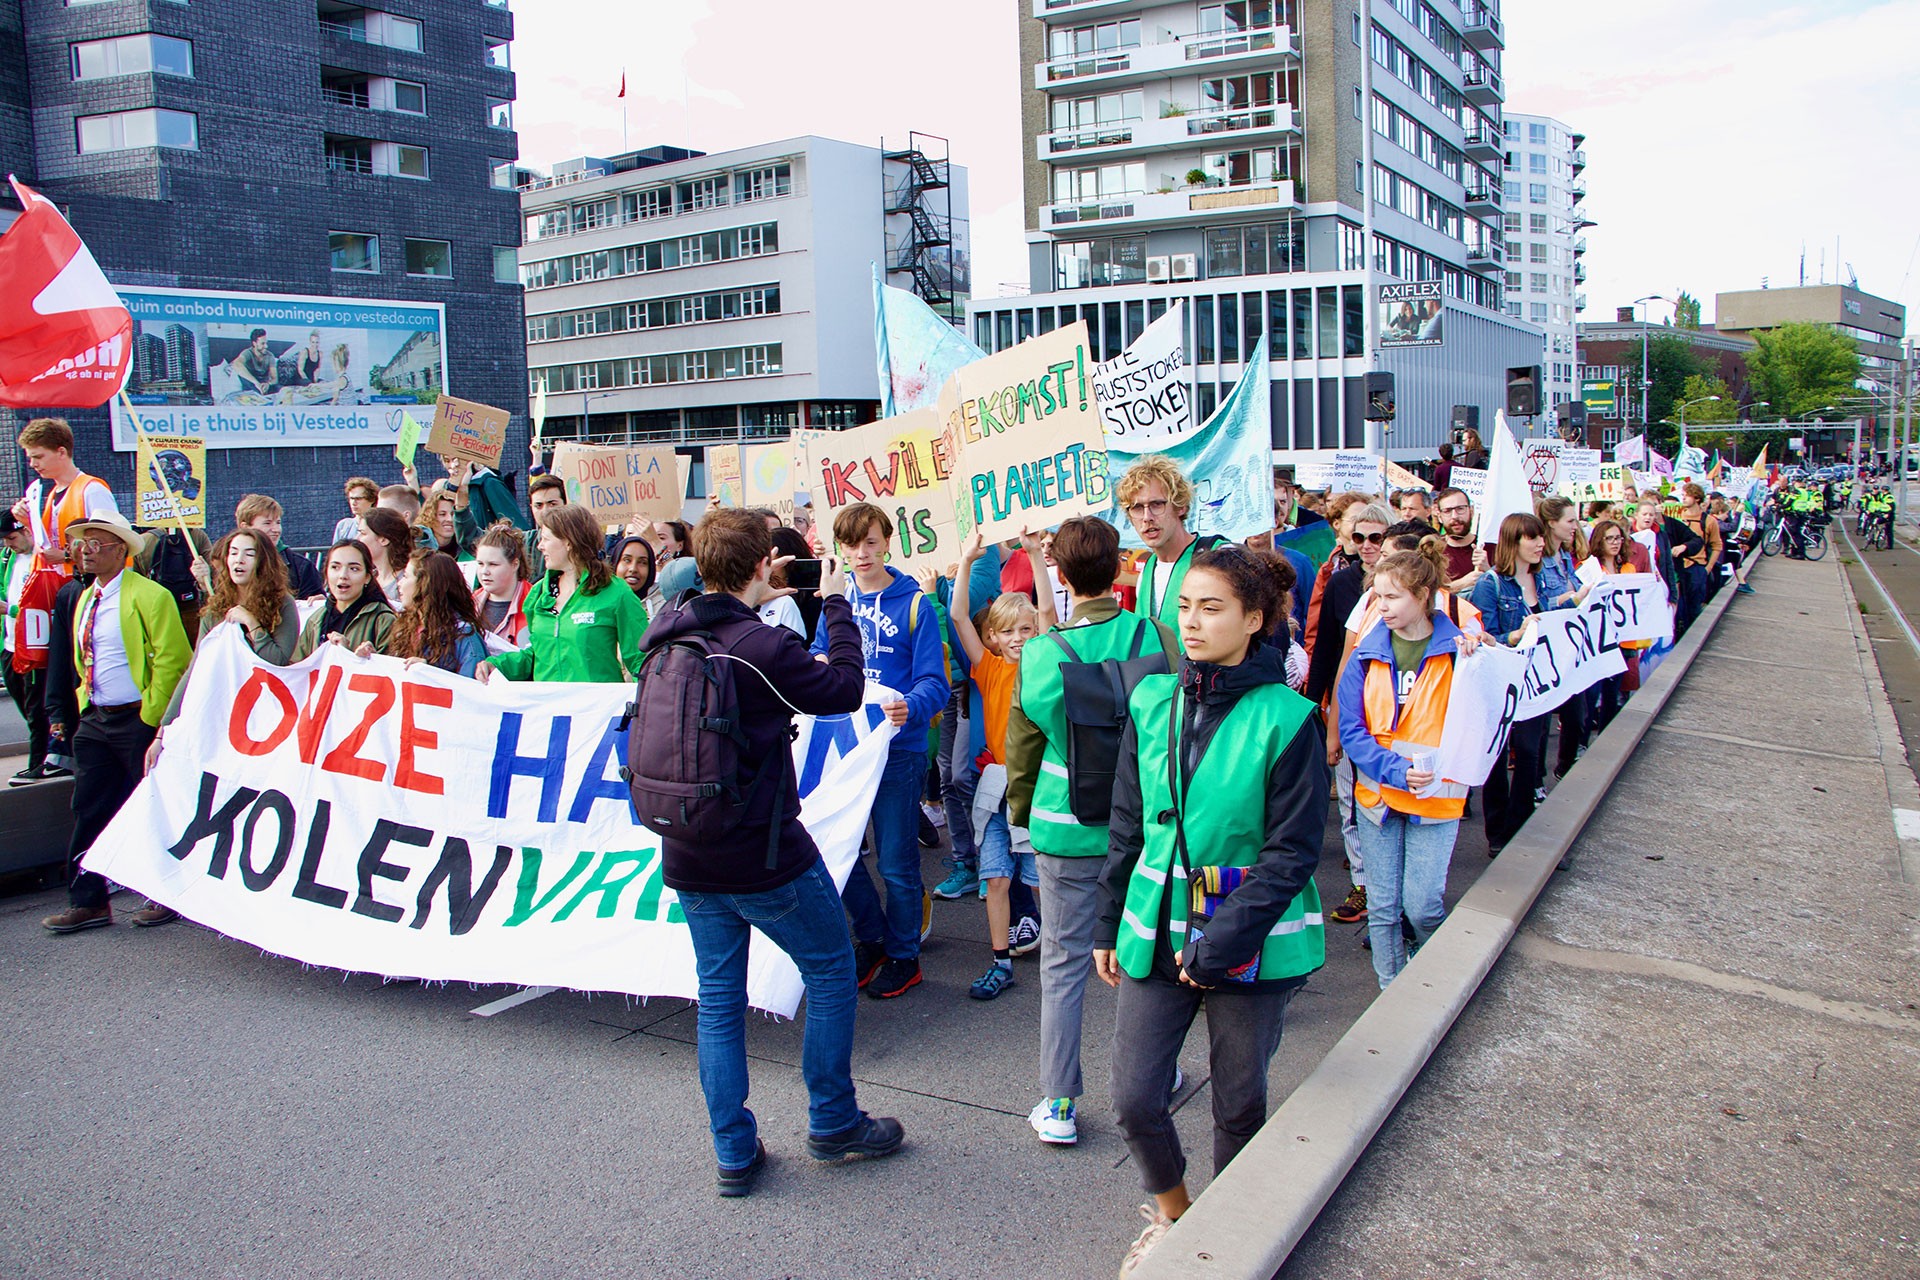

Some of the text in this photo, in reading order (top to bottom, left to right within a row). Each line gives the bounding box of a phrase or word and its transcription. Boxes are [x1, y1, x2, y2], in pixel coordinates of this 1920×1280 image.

[1381, 283, 1441, 298] AXIFLEX
[164, 301, 224, 316] aanbod
[228, 302, 331, 324] huurwoningen
[335, 311, 352, 325] op
[354, 311, 435, 325] vesteda.com
[127, 411, 369, 436] Voel je thuis bij Vesteda
[450, 432, 502, 457] EMERGENCY
[1527, 444, 1561, 459] CHANGE
[1335, 453, 1367, 462] Rotterdam
[1350, 462, 1378, 471] vrijhaven
[578, 453, 662, 483] DONT BE A
[1453, 467, 1487, 479] Rotterda
[634, 477, 662, 502] FOOL
[970, 442, 1086, 525] PLANEET
[1082, 449, 1112, 505] B
[142, 490, 165, 501] END
[779, 499, 794, 515] NO
[228, 666, 454, 795] ONZE
